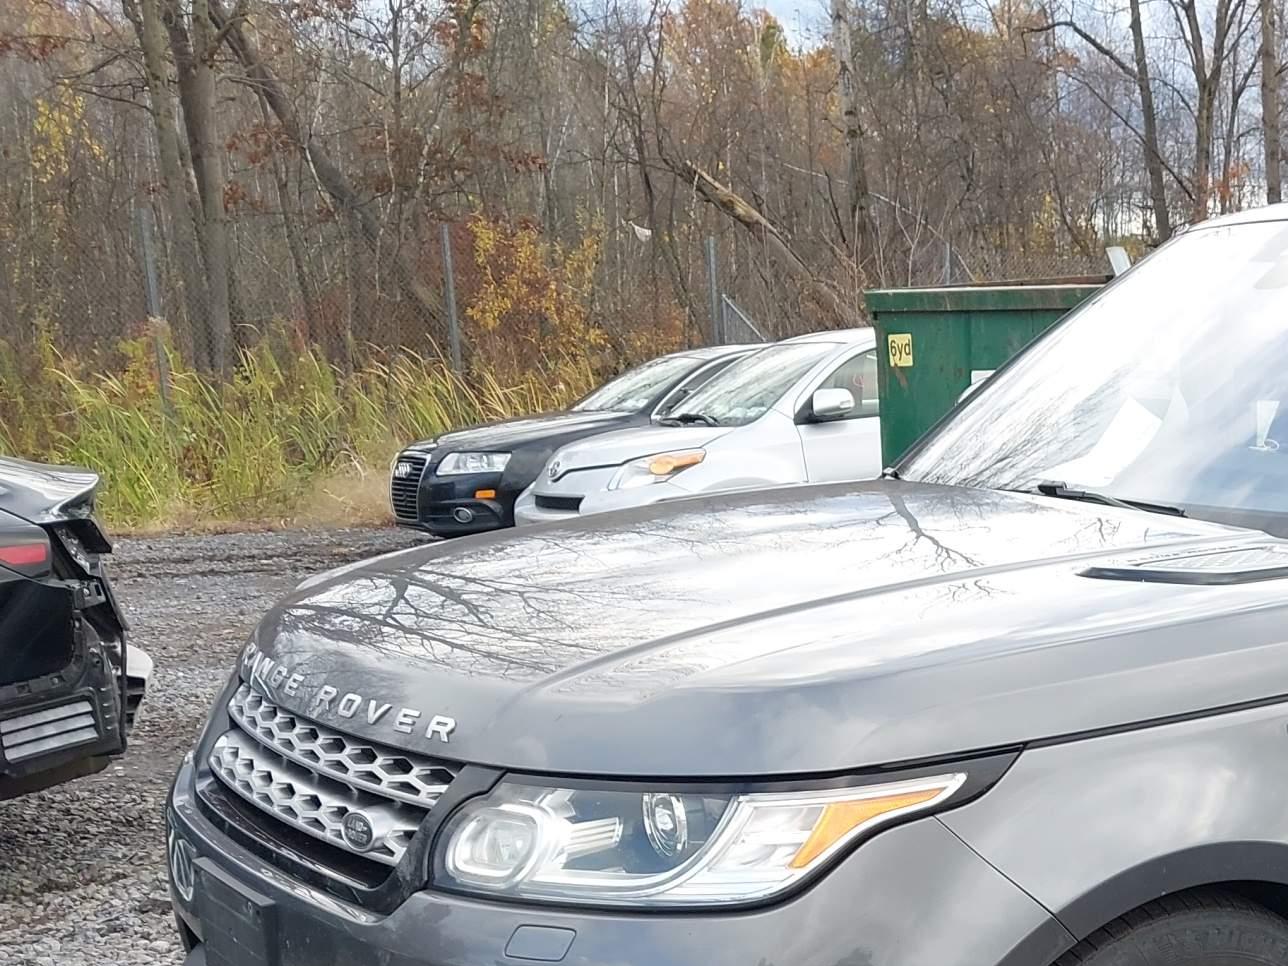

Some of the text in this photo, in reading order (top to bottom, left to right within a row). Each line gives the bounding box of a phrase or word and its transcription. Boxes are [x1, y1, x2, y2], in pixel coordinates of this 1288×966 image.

[890, 338, 912, 361] 6yd
[241, 642, 457, 743] RANGE ROVER
